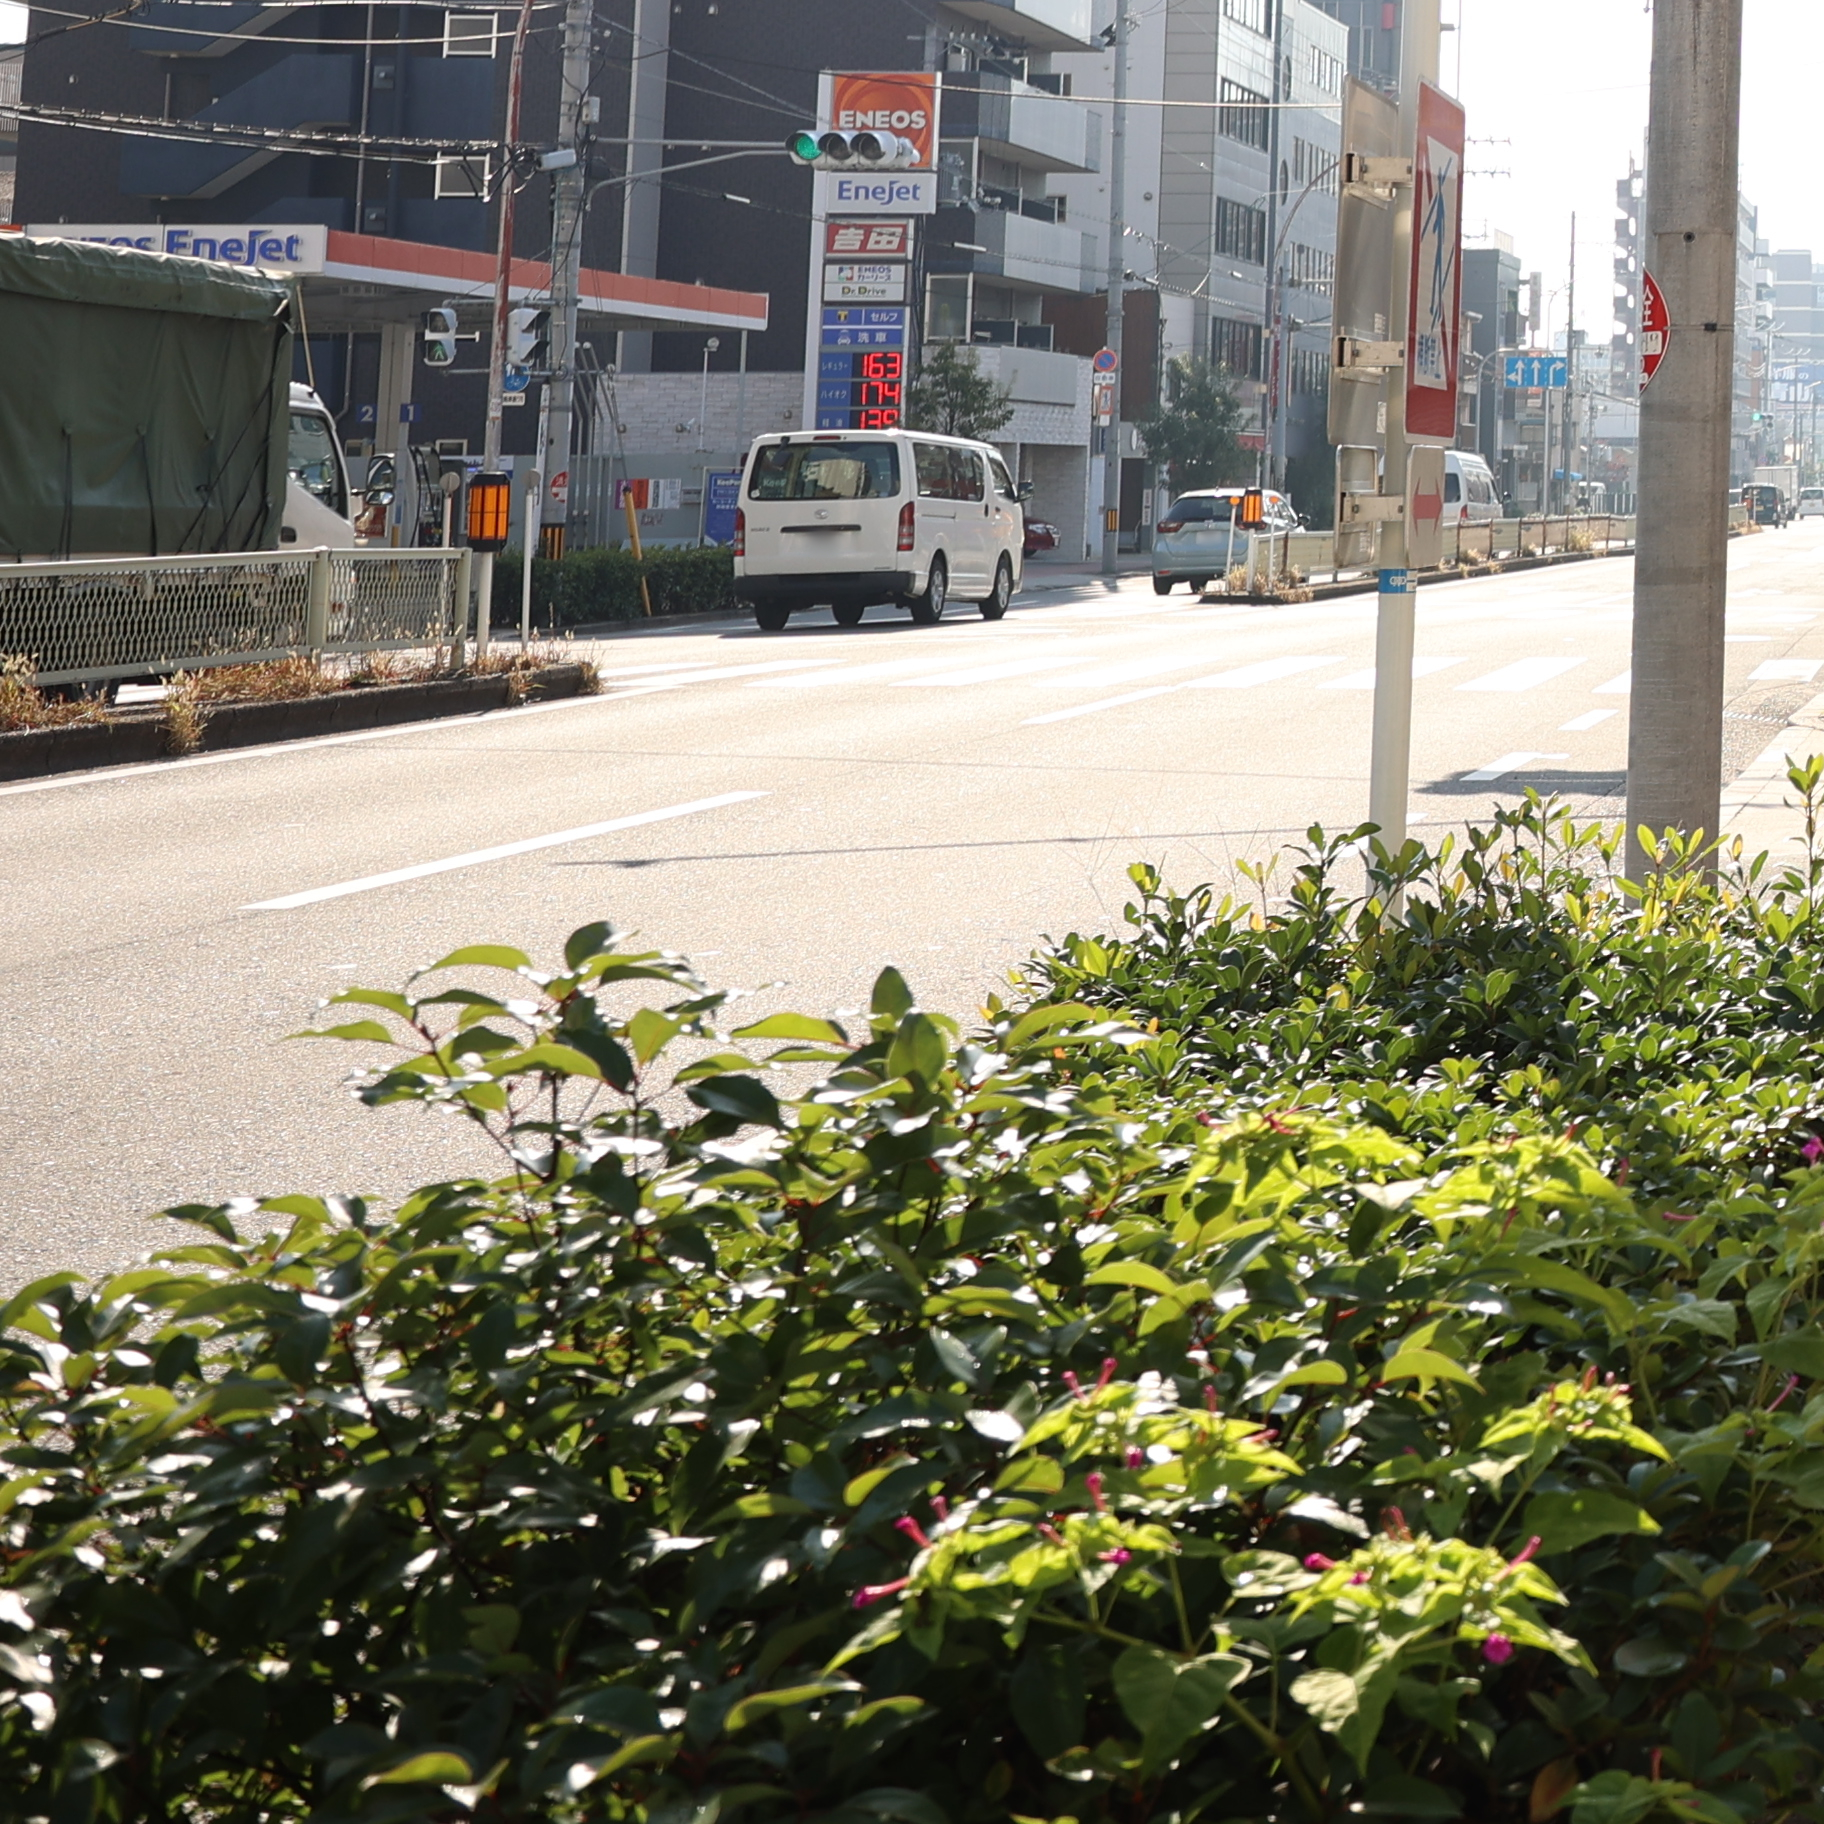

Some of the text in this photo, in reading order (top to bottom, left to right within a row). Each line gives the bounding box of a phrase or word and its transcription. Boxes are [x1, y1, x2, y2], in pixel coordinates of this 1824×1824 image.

[838, 109, 926, 130] ENEOS
[837, 180, 921, 206] EneJet
[165, 229, 302, 265] EneJet
[870, 312, 899, 323] セルフ
[862, 352, 901, 379] 163
[860, 381, 900, 406] 174
[361, 405, 374, 421] 2
[407, 405, 415, 420] 1
